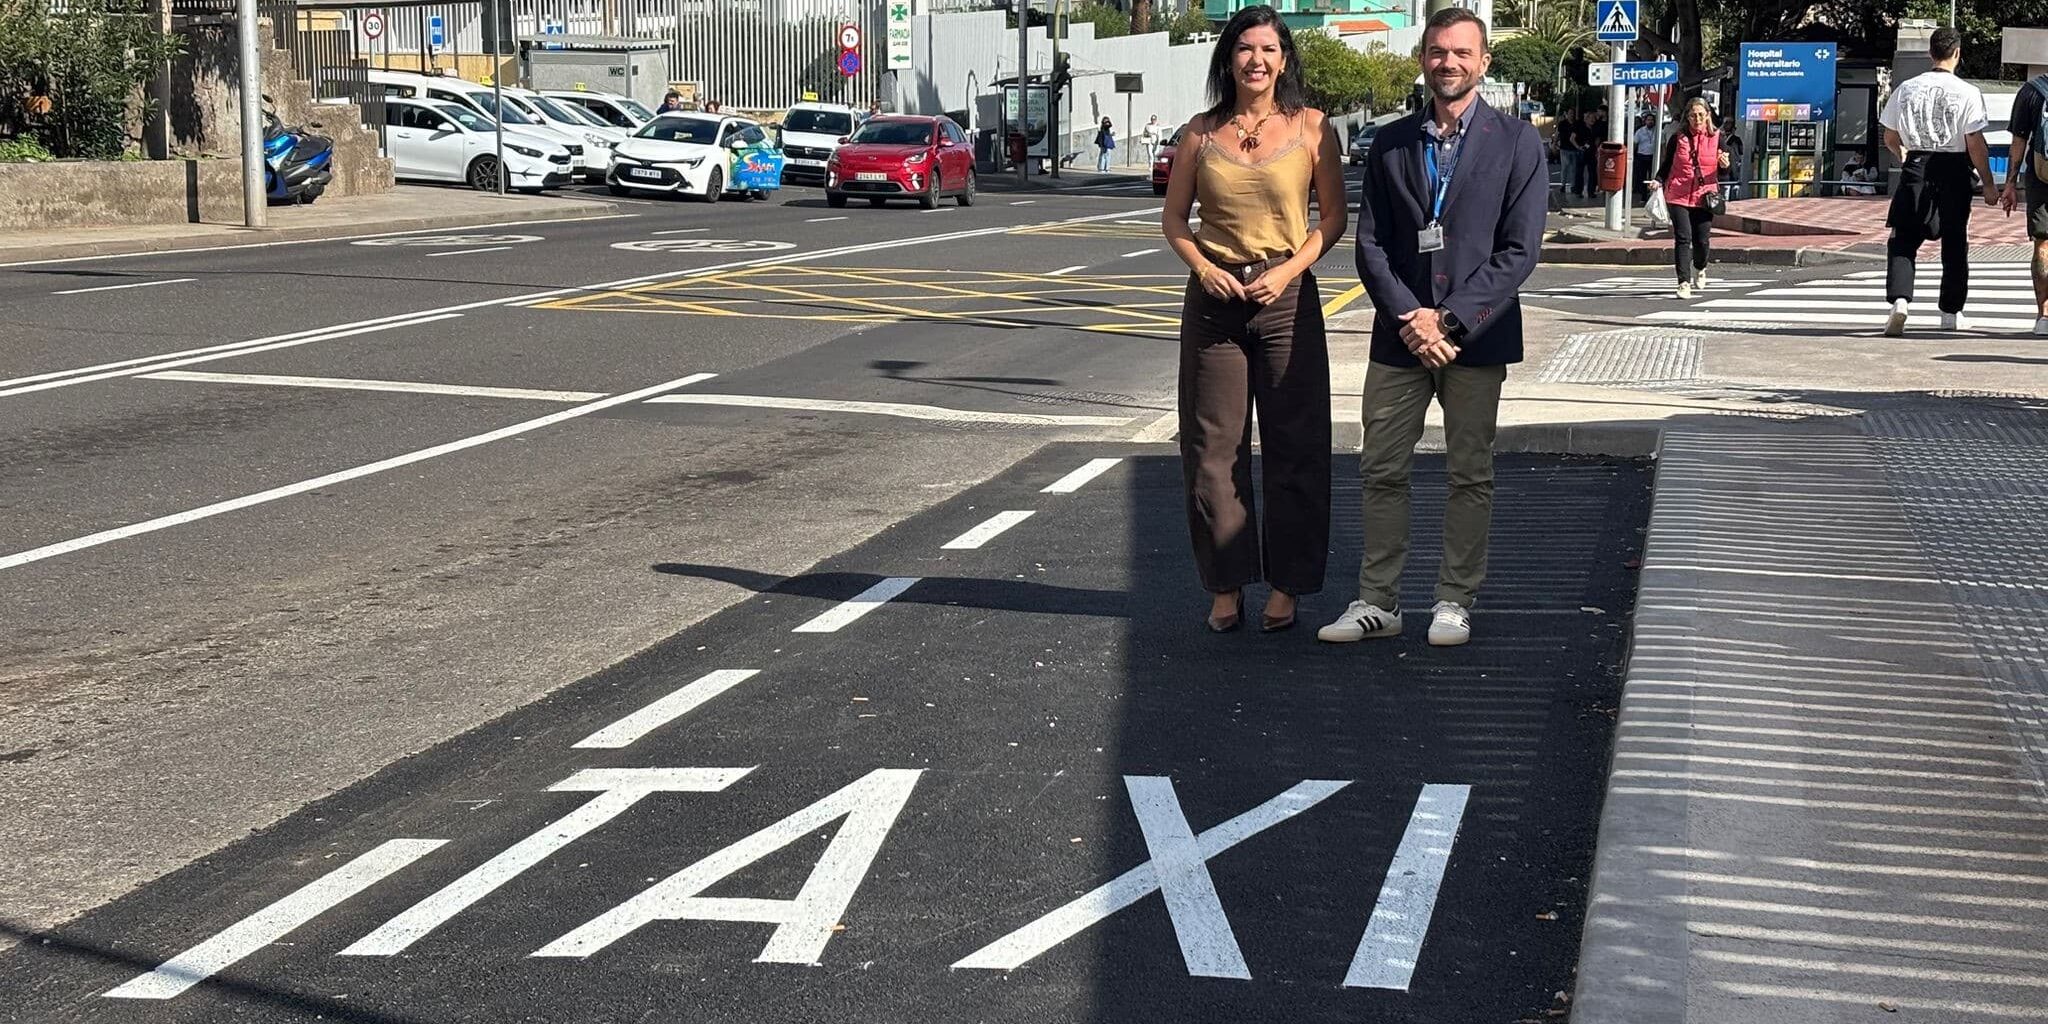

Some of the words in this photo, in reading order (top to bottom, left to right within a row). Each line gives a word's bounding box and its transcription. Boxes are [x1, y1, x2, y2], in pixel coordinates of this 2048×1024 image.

[368, 21, 380, 30] 30
[1747, 49, 1783, 59] Hospital
[1747, 60, 1801, 68] Universitario
[609, 67, 625, 76] WC
[1613, 67, 1664, 80] Entrada
[1750, 109, 1759, 117] A1
[342, 766, 1470, 990] TAXI
